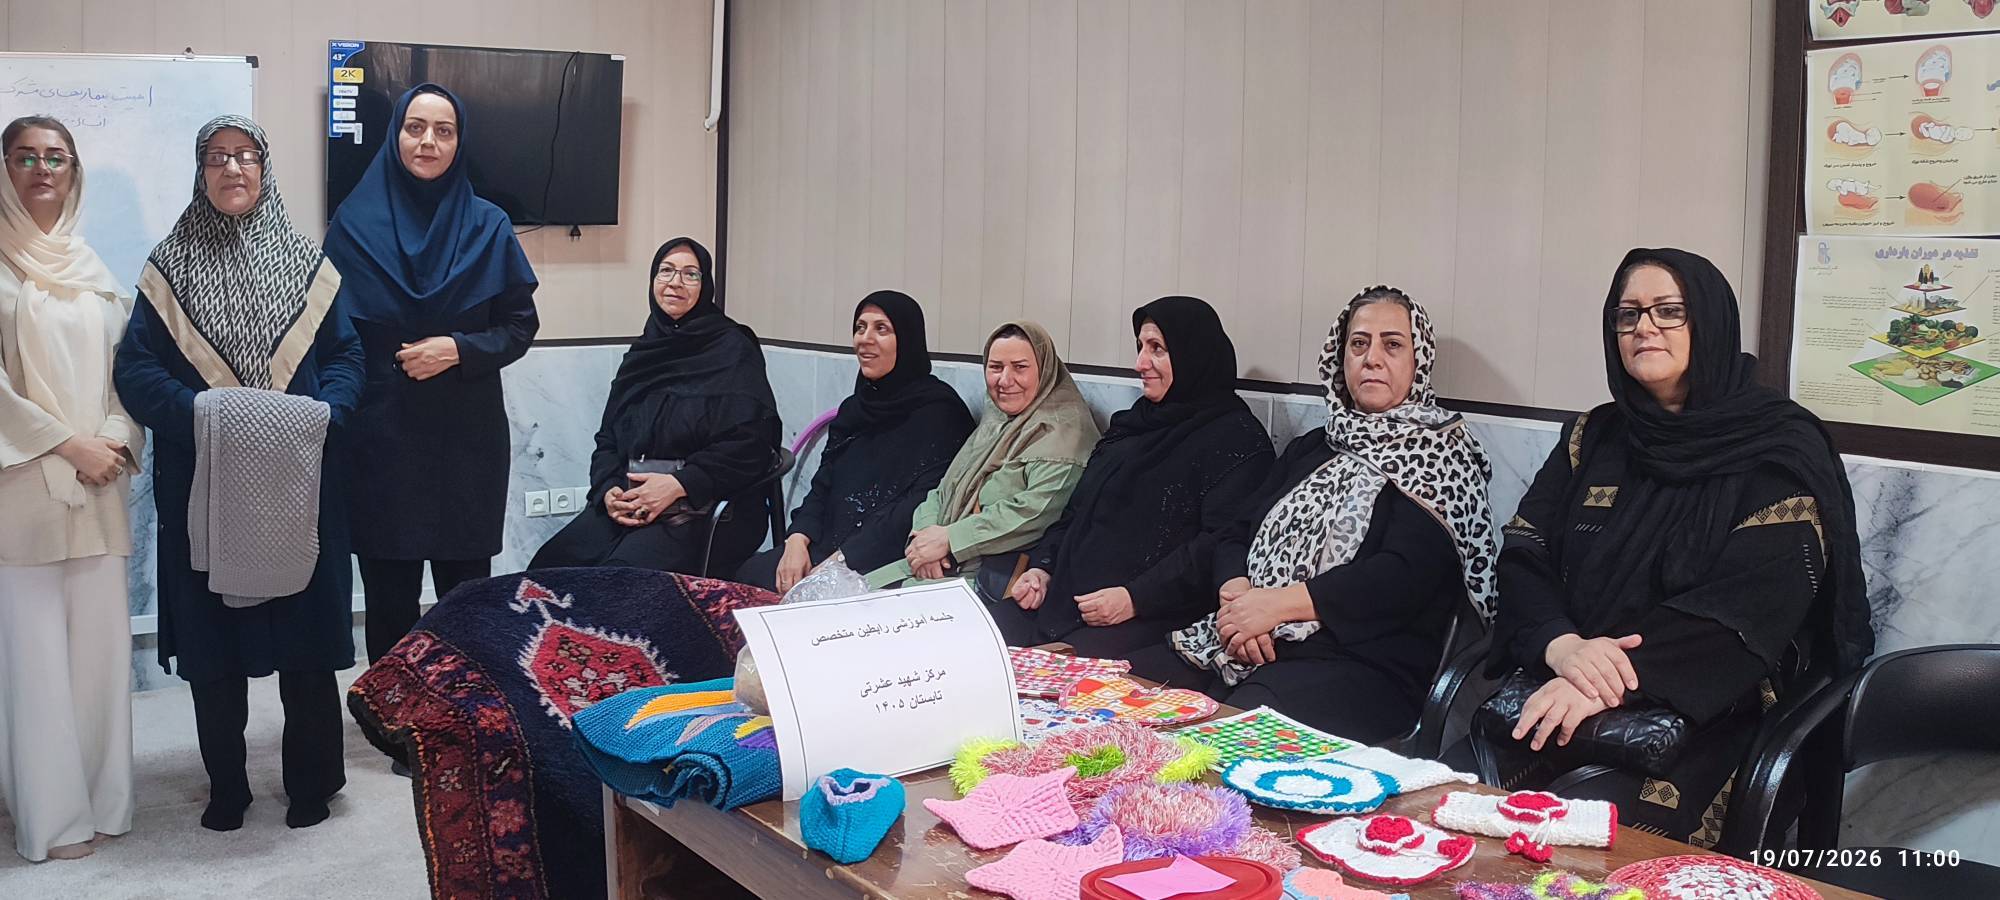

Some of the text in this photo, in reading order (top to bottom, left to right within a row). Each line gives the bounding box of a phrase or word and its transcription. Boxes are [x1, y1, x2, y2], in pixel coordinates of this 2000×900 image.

[341, 69, 356, 78] 2K
[930, 612, 954, 623] جلسه
[811, 628, 854, 646] متخصص
[858, 623, 890, 638] رابطین
[860, 668, 946, 698] مرکز شهید عشرتی
[875, 690, 943, 713] تابستان ۱۴۰۵
